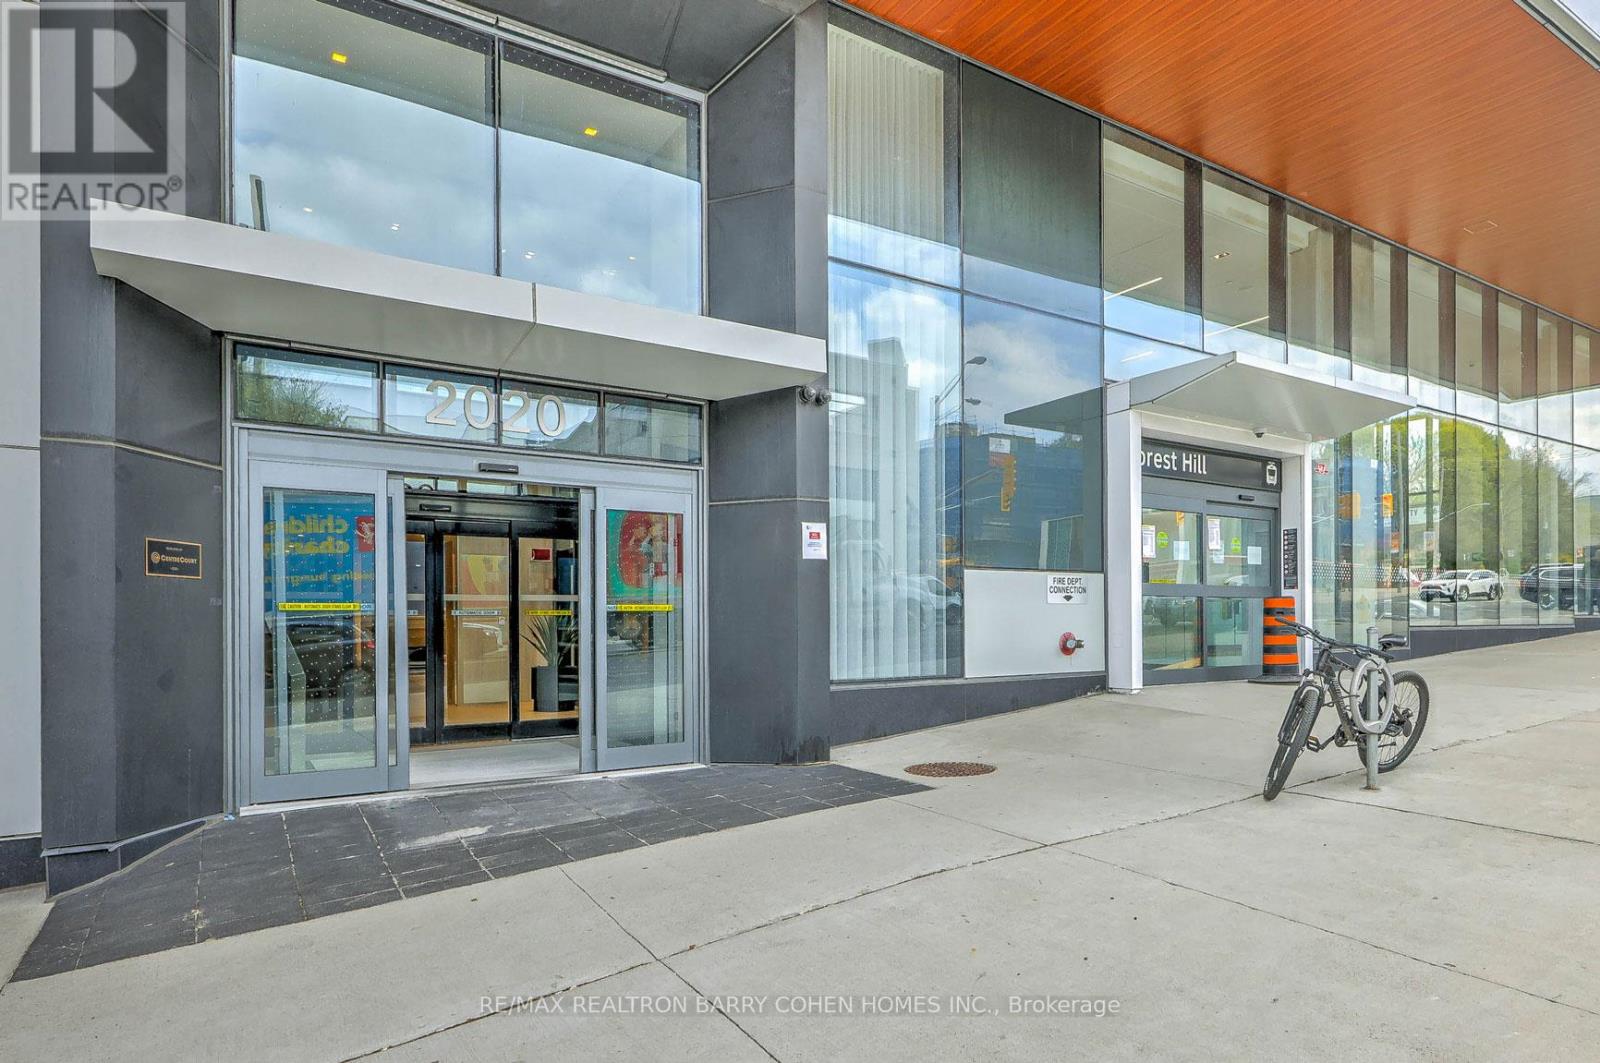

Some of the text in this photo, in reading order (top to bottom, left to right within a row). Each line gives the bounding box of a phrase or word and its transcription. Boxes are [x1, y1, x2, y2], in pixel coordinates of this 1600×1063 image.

[425, 380, 566, 437] 2020
[1140, 450, 1207, 475] orest Hill
[1053, 577, 1066, 585] FIRE
